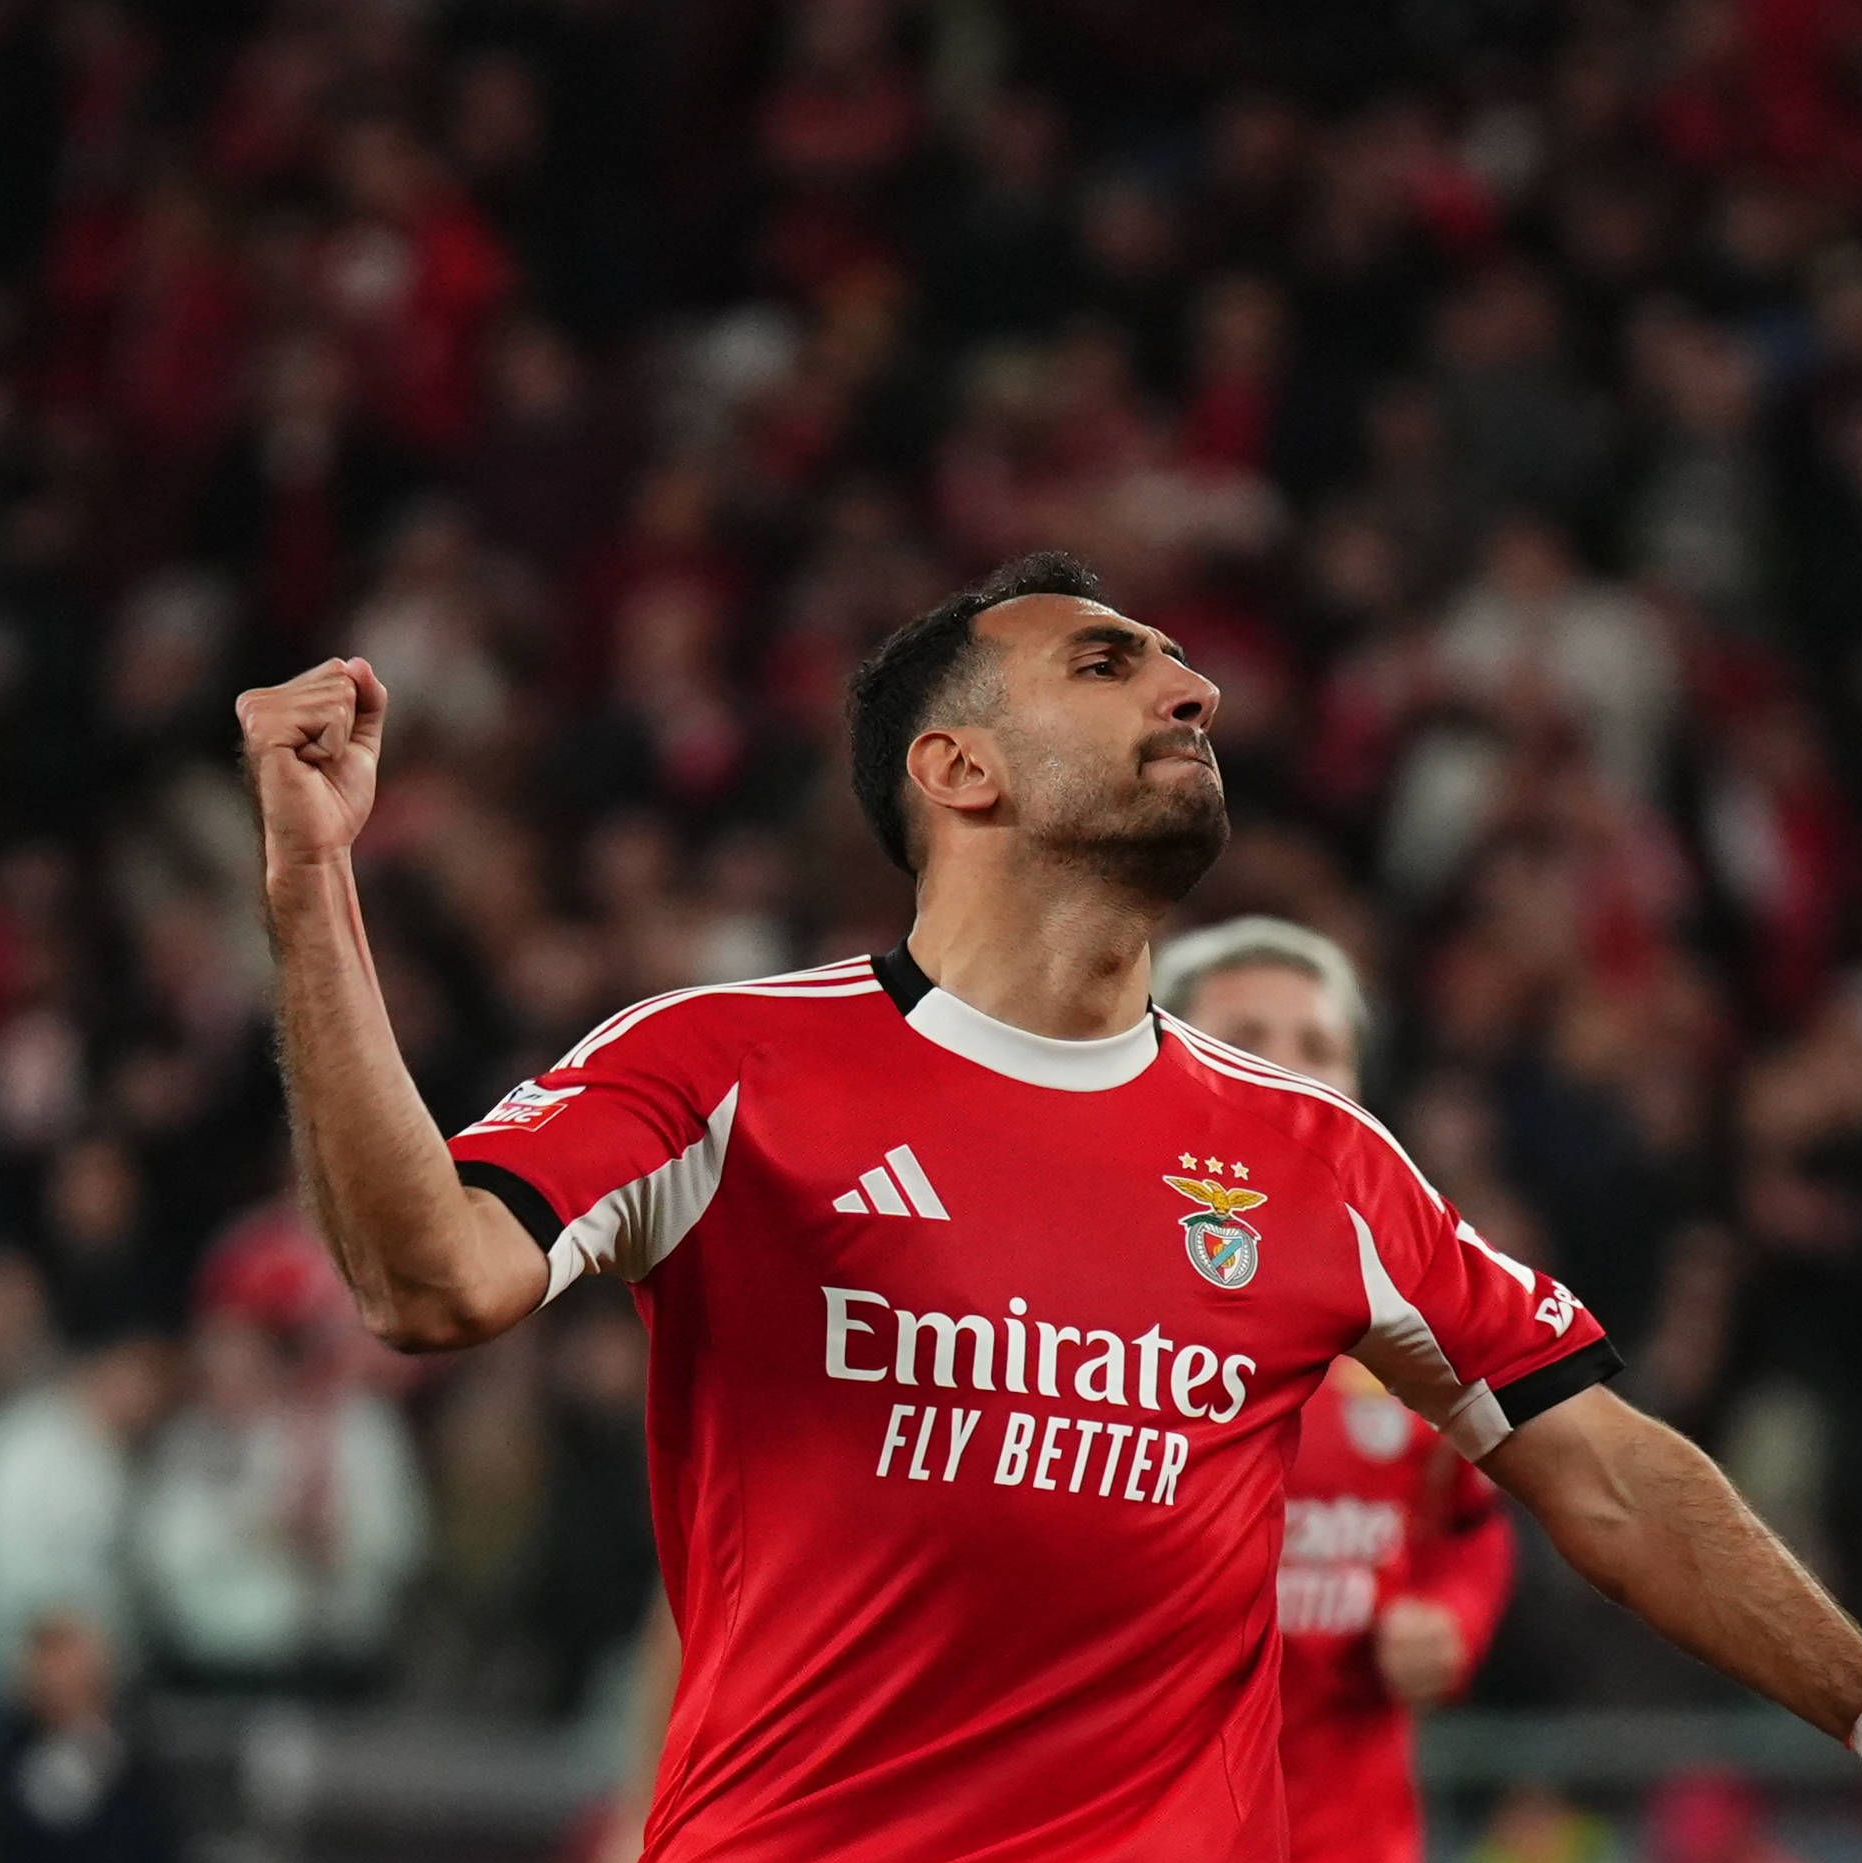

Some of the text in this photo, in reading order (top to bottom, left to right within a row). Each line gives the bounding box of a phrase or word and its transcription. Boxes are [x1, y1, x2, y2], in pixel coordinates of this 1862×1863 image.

[821, 1286, 1256, 1423] Emirates
[876, 1404, 1189, 1505] FLY BETTER
